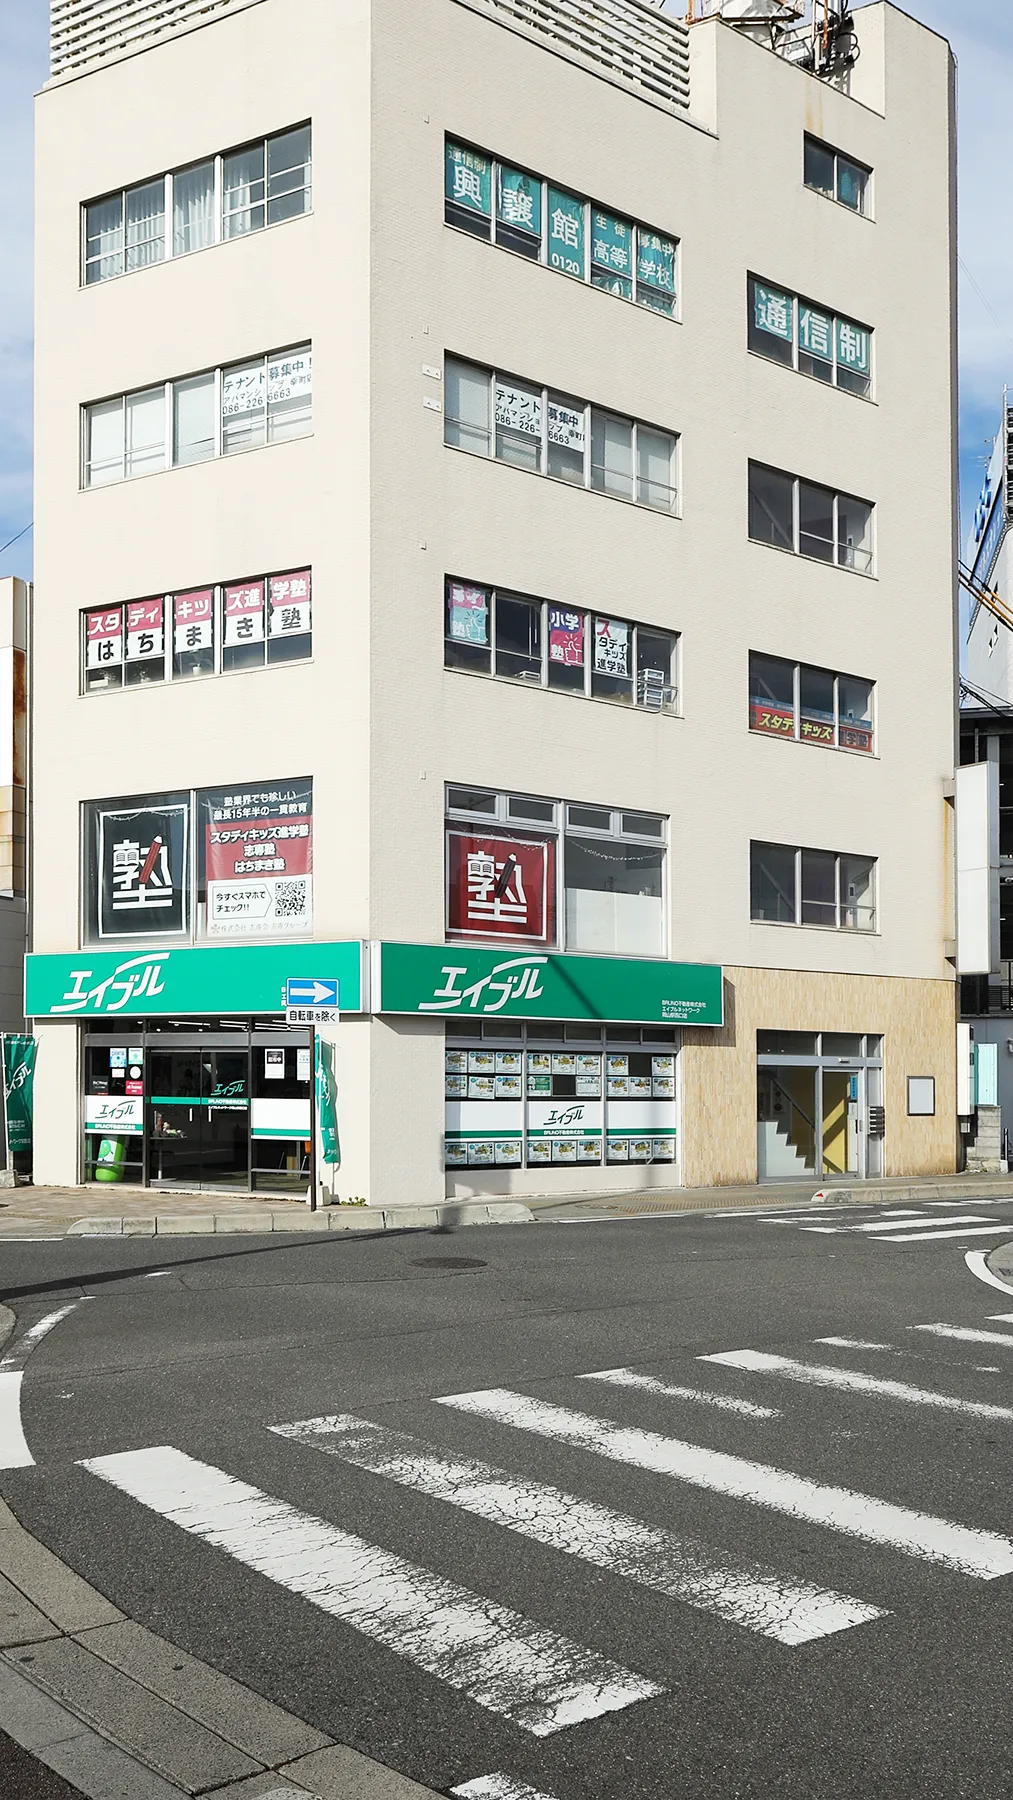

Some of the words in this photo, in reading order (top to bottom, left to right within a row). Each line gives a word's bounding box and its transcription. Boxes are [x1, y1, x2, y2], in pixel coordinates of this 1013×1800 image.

[552, 252, 580, 275] 0120
[758, 289, 867, 370] 通信制
[551, 610, 580, 631] 小学
[551, 643, 565, 661] 塾
[224, 791, 297, 807] 塾業界でも珍しい
[210, 824, 309, 844] スタディキッズ進学塾
[234, 858, 286, 873] はちまき塾
[51, 952, 170, 1013] エイブル
[418, 956, 549, 1012] エイブル
[289, 1010, 336, 1022] 自転車を除く
[94, 1100, 136, 1119] エイブル
[543, 1104, 585, 1125] エイブル
